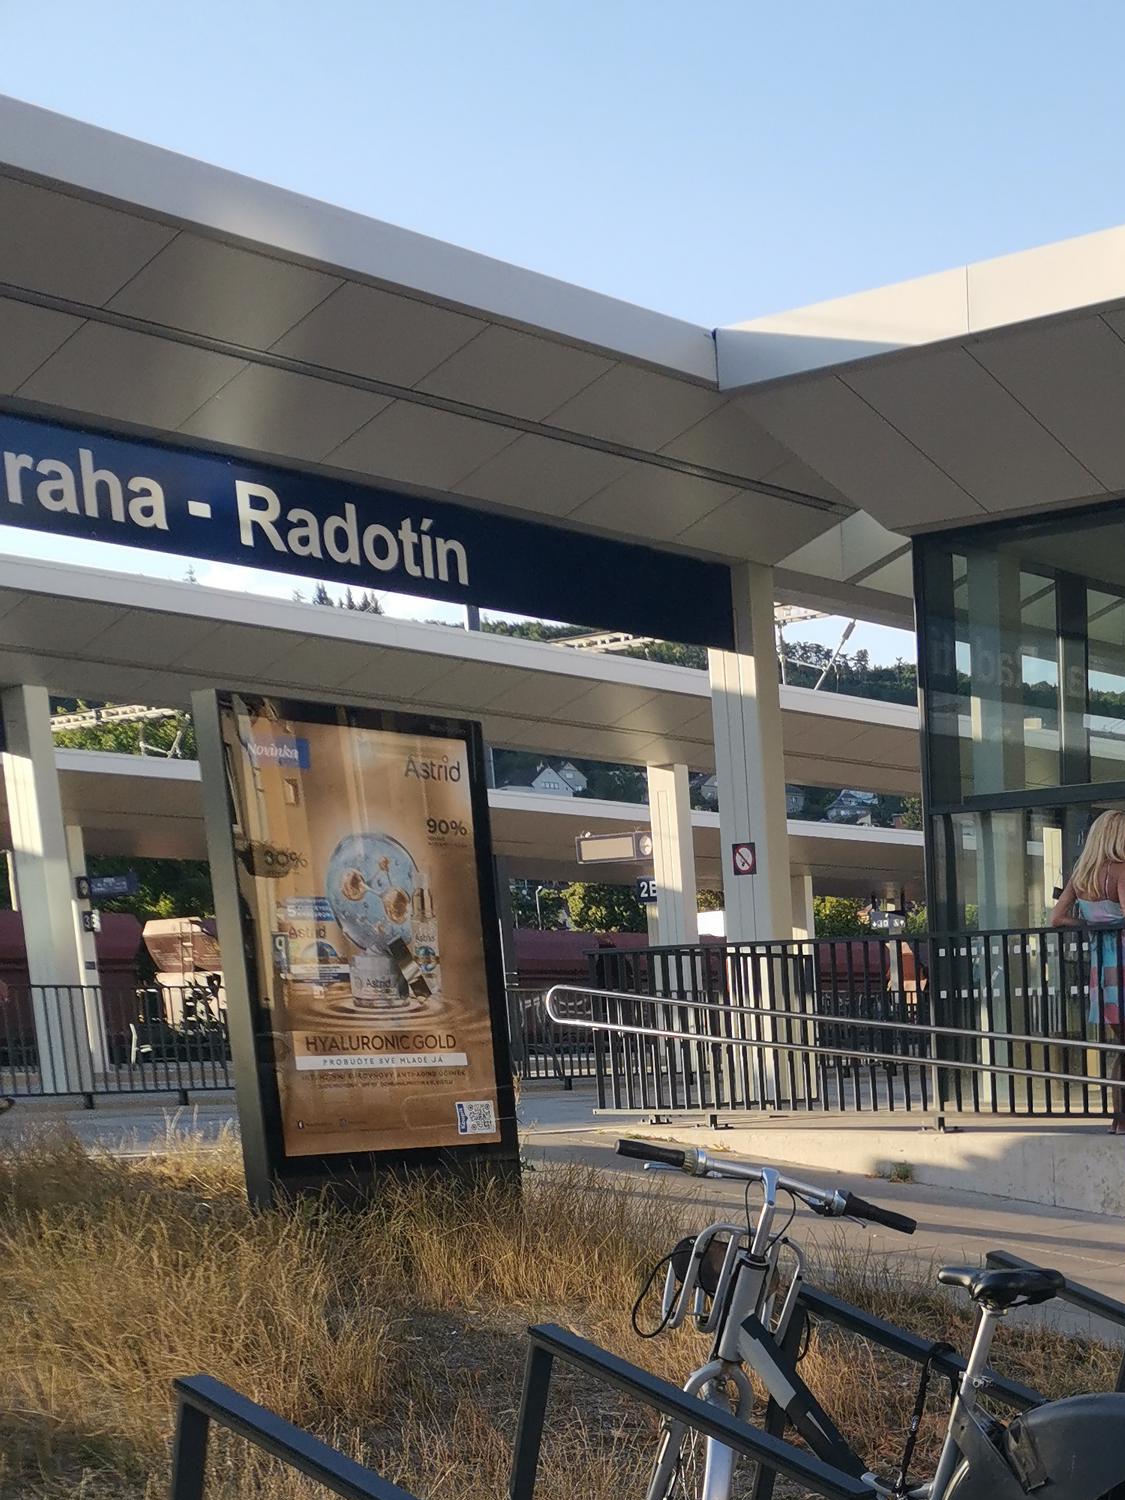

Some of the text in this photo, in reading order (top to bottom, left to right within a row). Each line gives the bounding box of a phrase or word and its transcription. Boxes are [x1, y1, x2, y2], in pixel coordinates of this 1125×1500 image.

[235, 479, 470, 586] Radotín
[404, 755, 461, 783] Astrid
[427, 817, 468, 836] 90%
[264, 849, 308, 868] 30%
[305, 1034, 457, 1052] HYALURONIC GOLD
